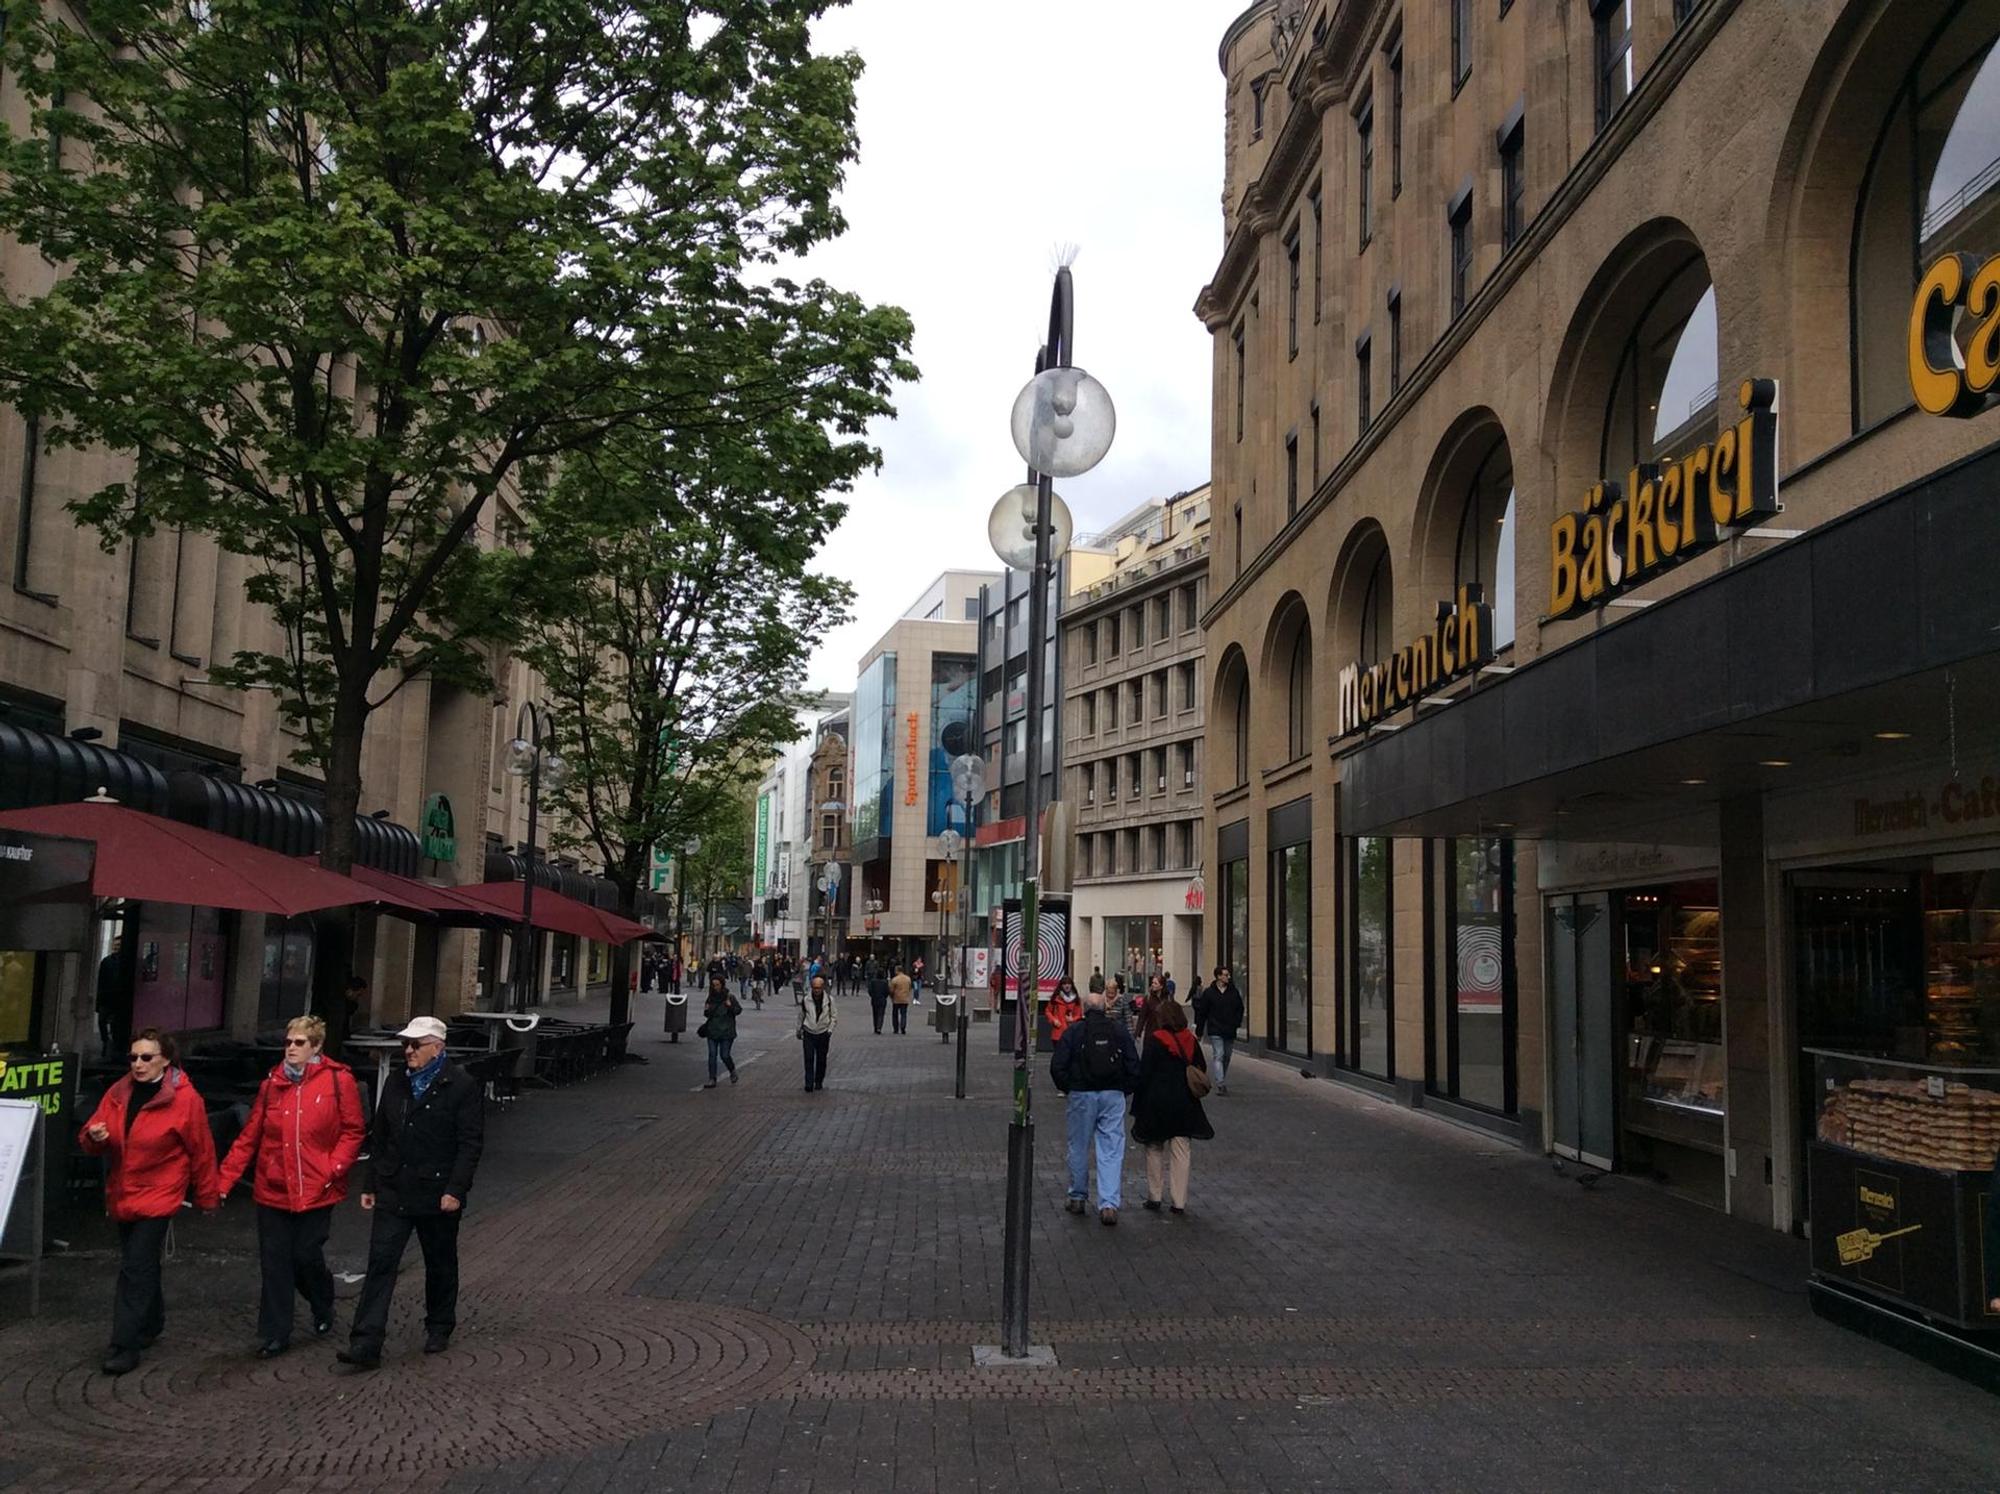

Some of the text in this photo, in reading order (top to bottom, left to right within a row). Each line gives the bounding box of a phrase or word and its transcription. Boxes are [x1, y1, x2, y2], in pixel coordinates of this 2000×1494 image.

[1549, 378, 1772, 618] Bäckerei
[759, 797, 768, 833] BENETTON
[758, 843, 766, 870] COLORS
